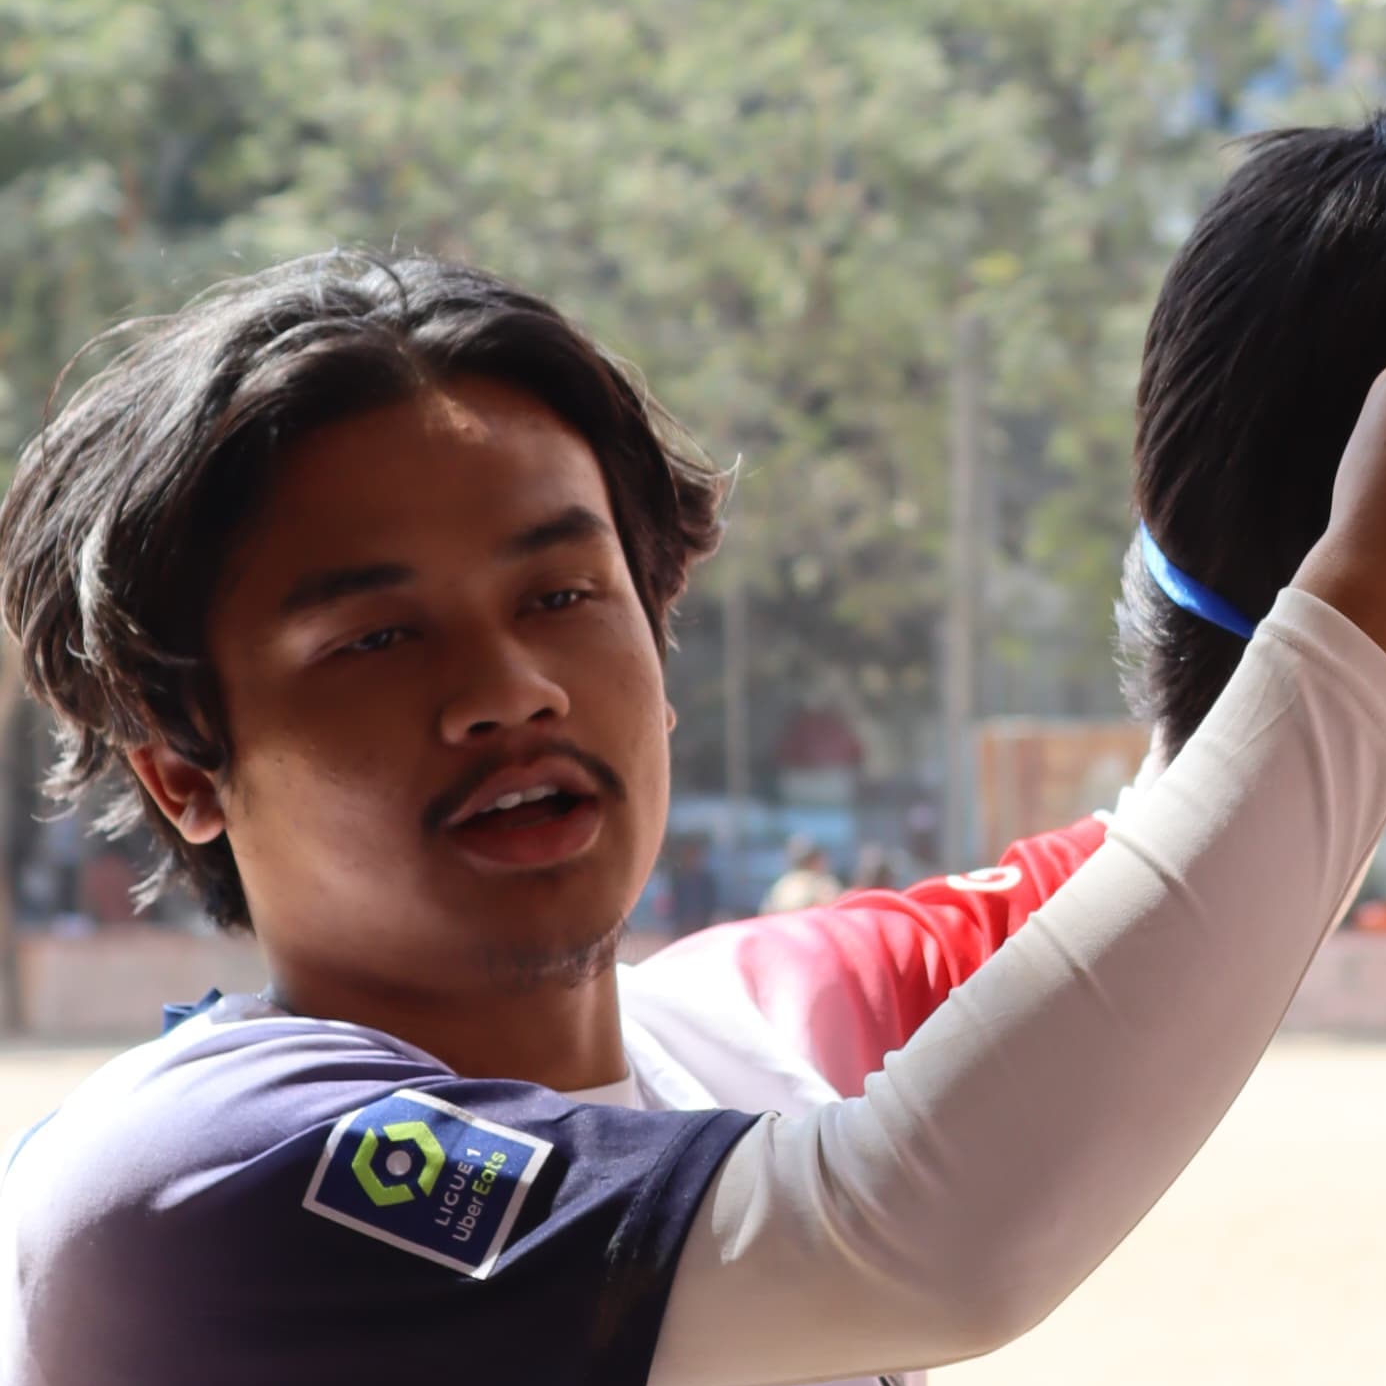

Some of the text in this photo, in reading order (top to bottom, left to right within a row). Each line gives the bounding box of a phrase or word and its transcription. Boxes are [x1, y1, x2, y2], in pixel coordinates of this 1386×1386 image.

[467, 1148, 481, 1156] 1
[452, 1151, 507, 1241] Uber Eats
